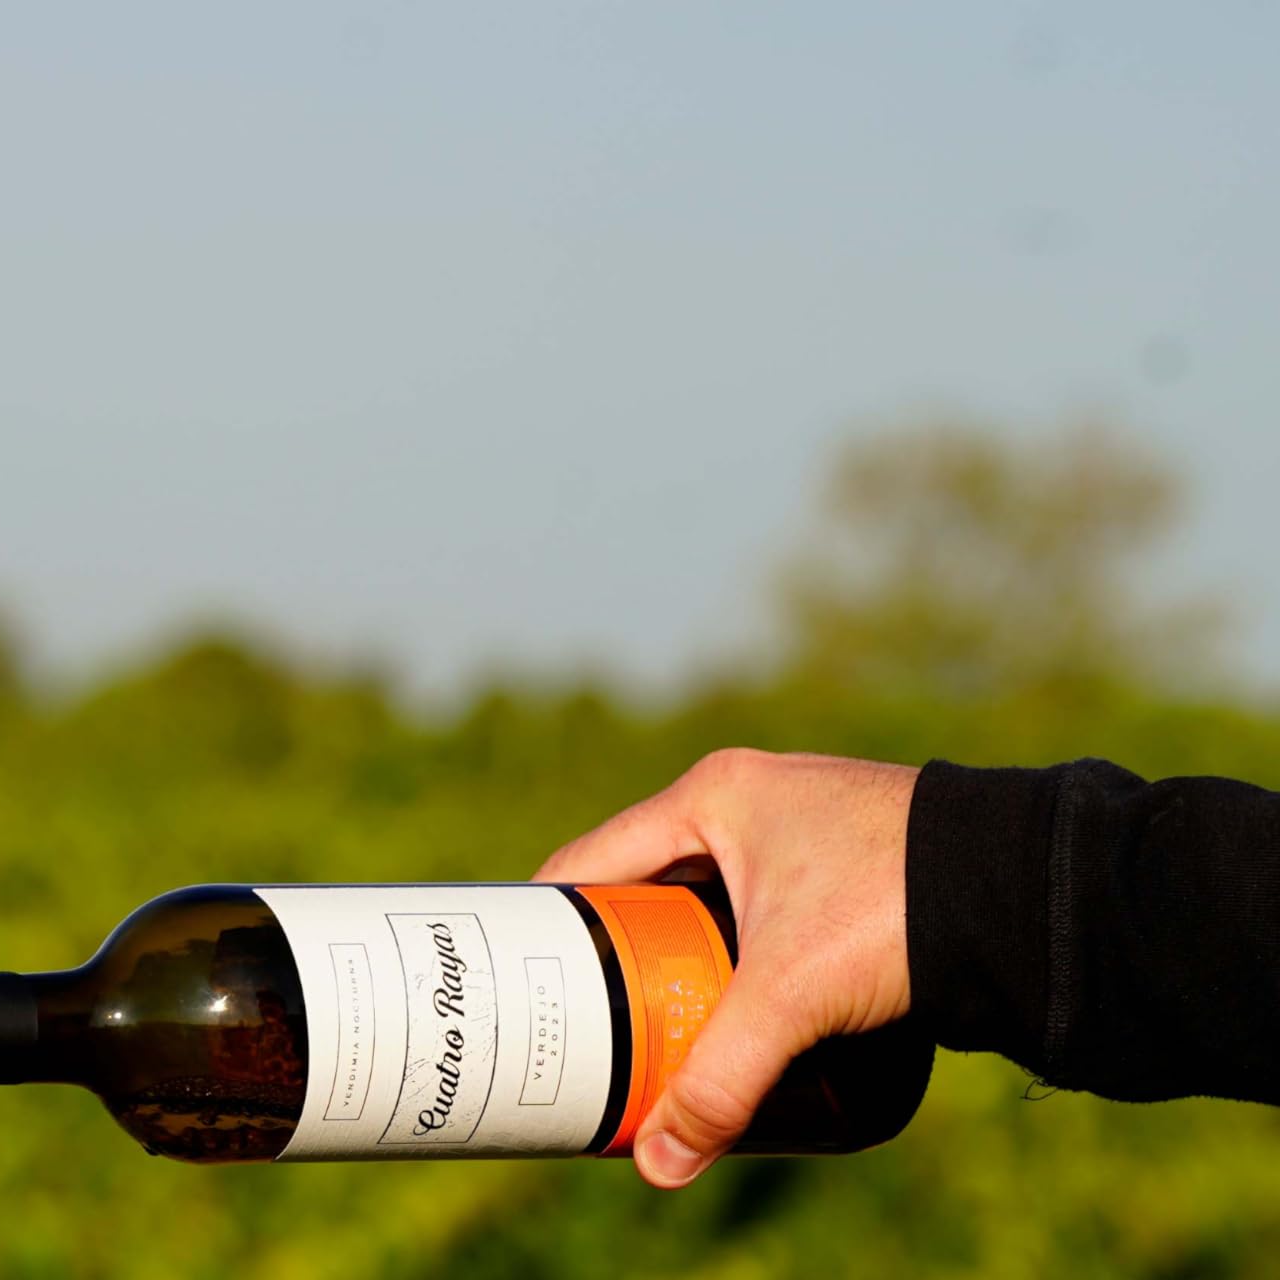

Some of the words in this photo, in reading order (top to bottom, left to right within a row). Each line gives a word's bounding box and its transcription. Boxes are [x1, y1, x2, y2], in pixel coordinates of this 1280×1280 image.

[348, 959, 360, 1034] NOCTURNA
[425, 922, 467, 1018] Rayas
[533, 984, 548, 1080] VERDEJO
[550, 1002, 559, 1057] 2023
[664, 981, 683, 1065] UEDA
[343, 1042, 359, 1107] VENDIMIA
[412, 1024, 465, 1136] Cuatro
